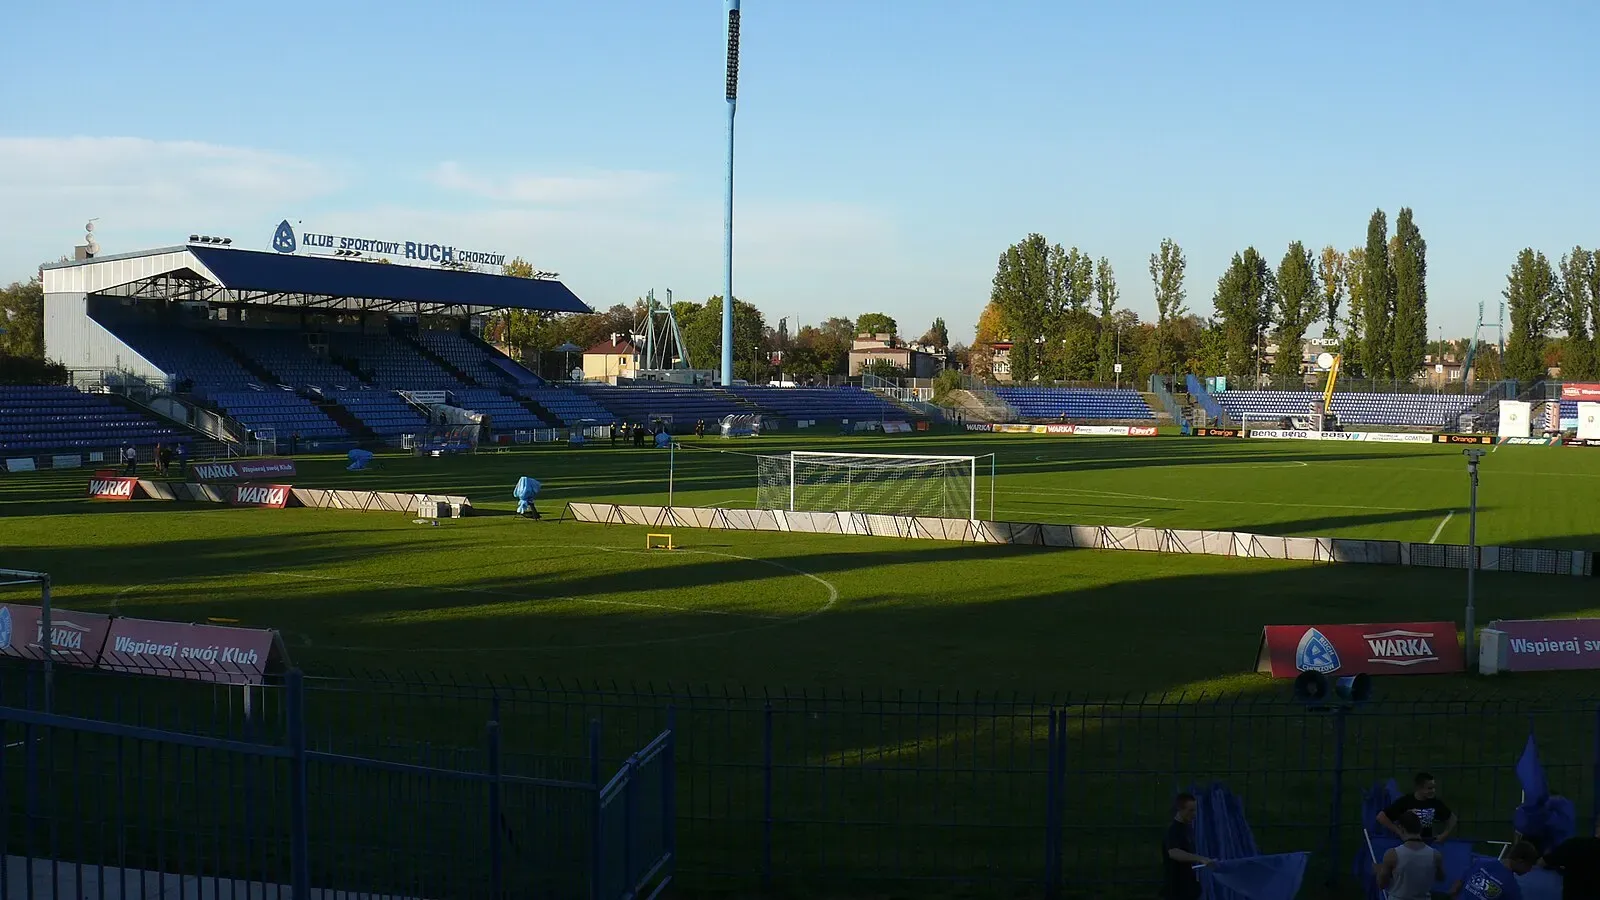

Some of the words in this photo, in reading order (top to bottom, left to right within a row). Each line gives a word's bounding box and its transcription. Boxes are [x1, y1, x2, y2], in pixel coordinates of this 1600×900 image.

[303, 232, 333, 248] KLUB
[340, 237, 400, 255] SPORTOWY
[405, 241, 452, 263] RUCH
[458, 250, 505, 266] CHORZÓW
[1312, 338, 1339, 346] OMEGA
[966, 423, 991, 432] WARKA
[1047, 425, 1073, 433] WARKA
[1210, 429, 1233, 437] Orange
[1452, 435, 1477, 443] Orange
[194, 464, 239, 480] WARKA
[89, 478, 131, 497] WARKA
[237, 485, 284, 505] WARKA
[114, 636, 177, 658] Wspieraj
[180, 645, 217, 664] swój
[222, 647, 258, 665] Klub
[1319, 636, 1334, 656] RUCH
[1368, 637, 1433, 657] WARKA
[1510, 636, 1581, 656] Wspieraj
